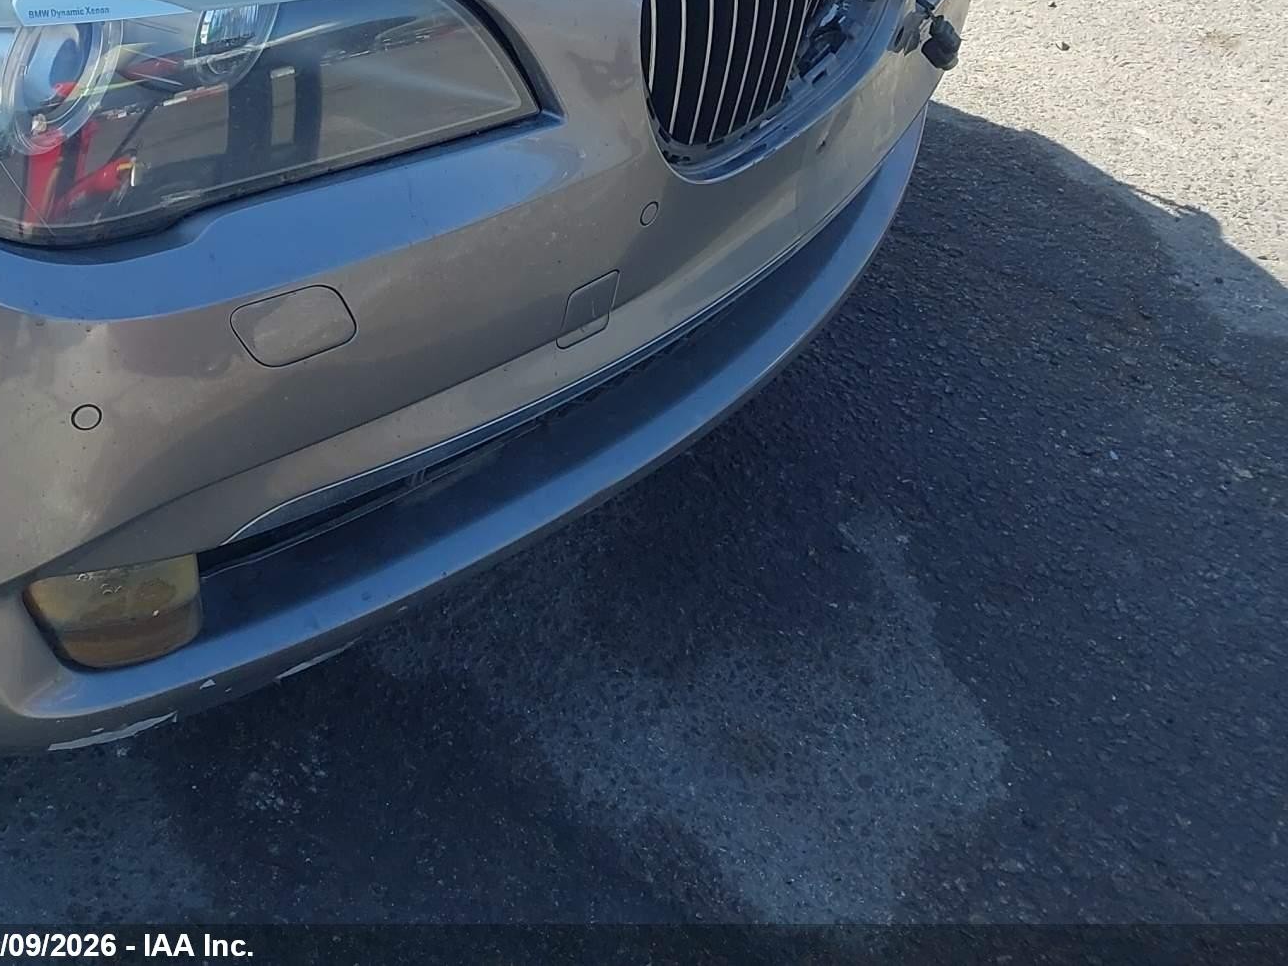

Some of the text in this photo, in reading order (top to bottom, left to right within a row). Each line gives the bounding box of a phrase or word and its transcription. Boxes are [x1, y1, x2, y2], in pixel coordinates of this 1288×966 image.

[28, 6, 110, 19] BMW Dynamic Xenon
